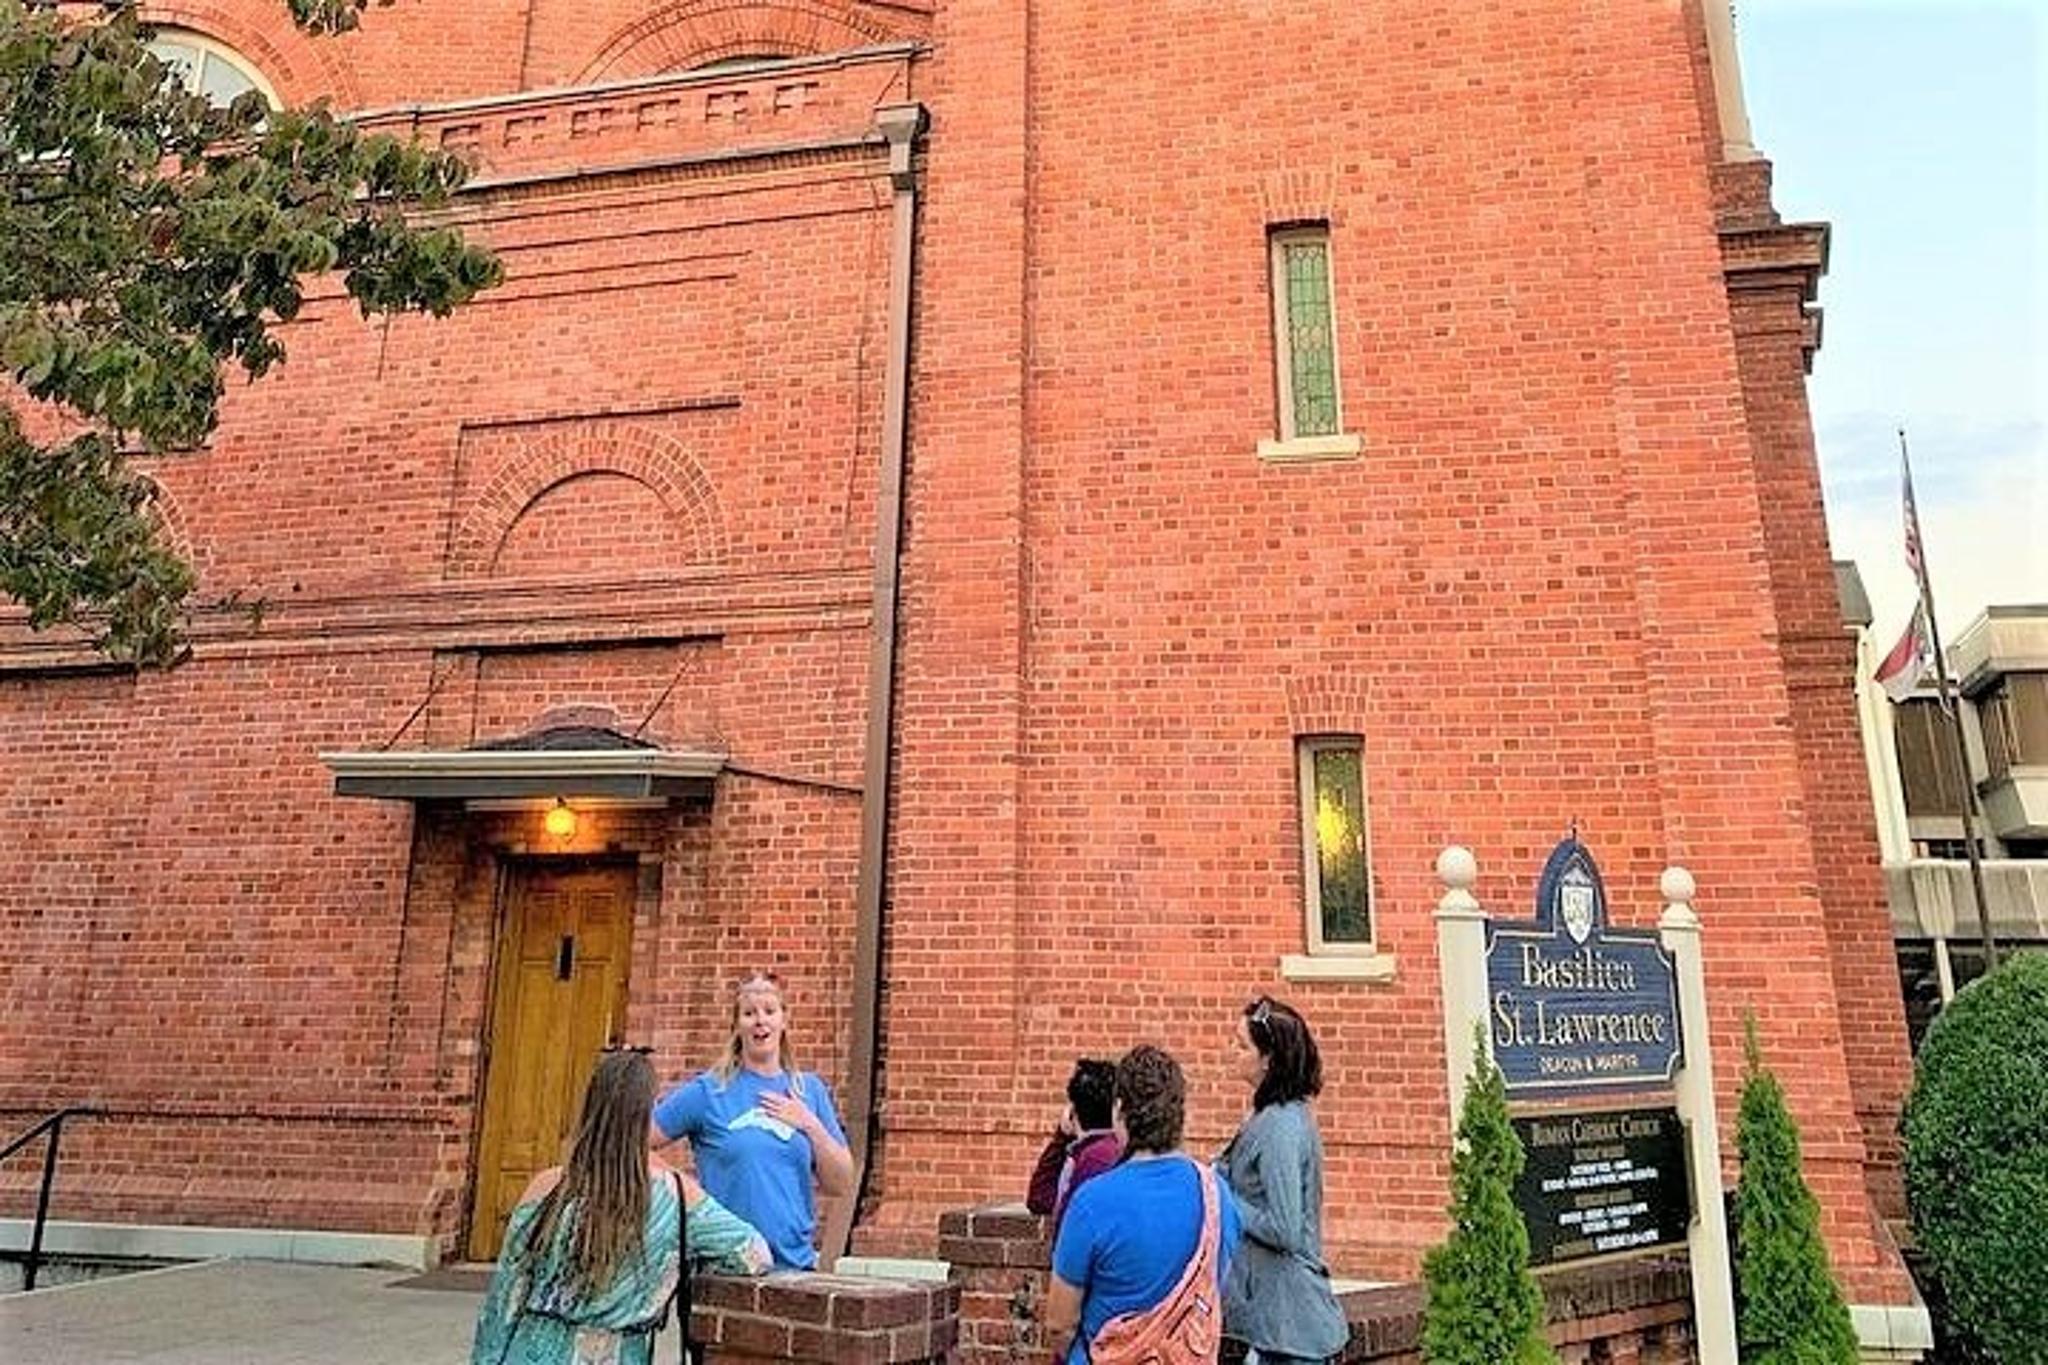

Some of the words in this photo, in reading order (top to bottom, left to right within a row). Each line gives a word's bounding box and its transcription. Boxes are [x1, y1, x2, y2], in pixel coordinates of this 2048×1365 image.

[1521, 943, 1636, 991] Basilica
[1494, 990, 1532, 1047] St.
[1537, 1000, 1665, 1046] Lawrence
